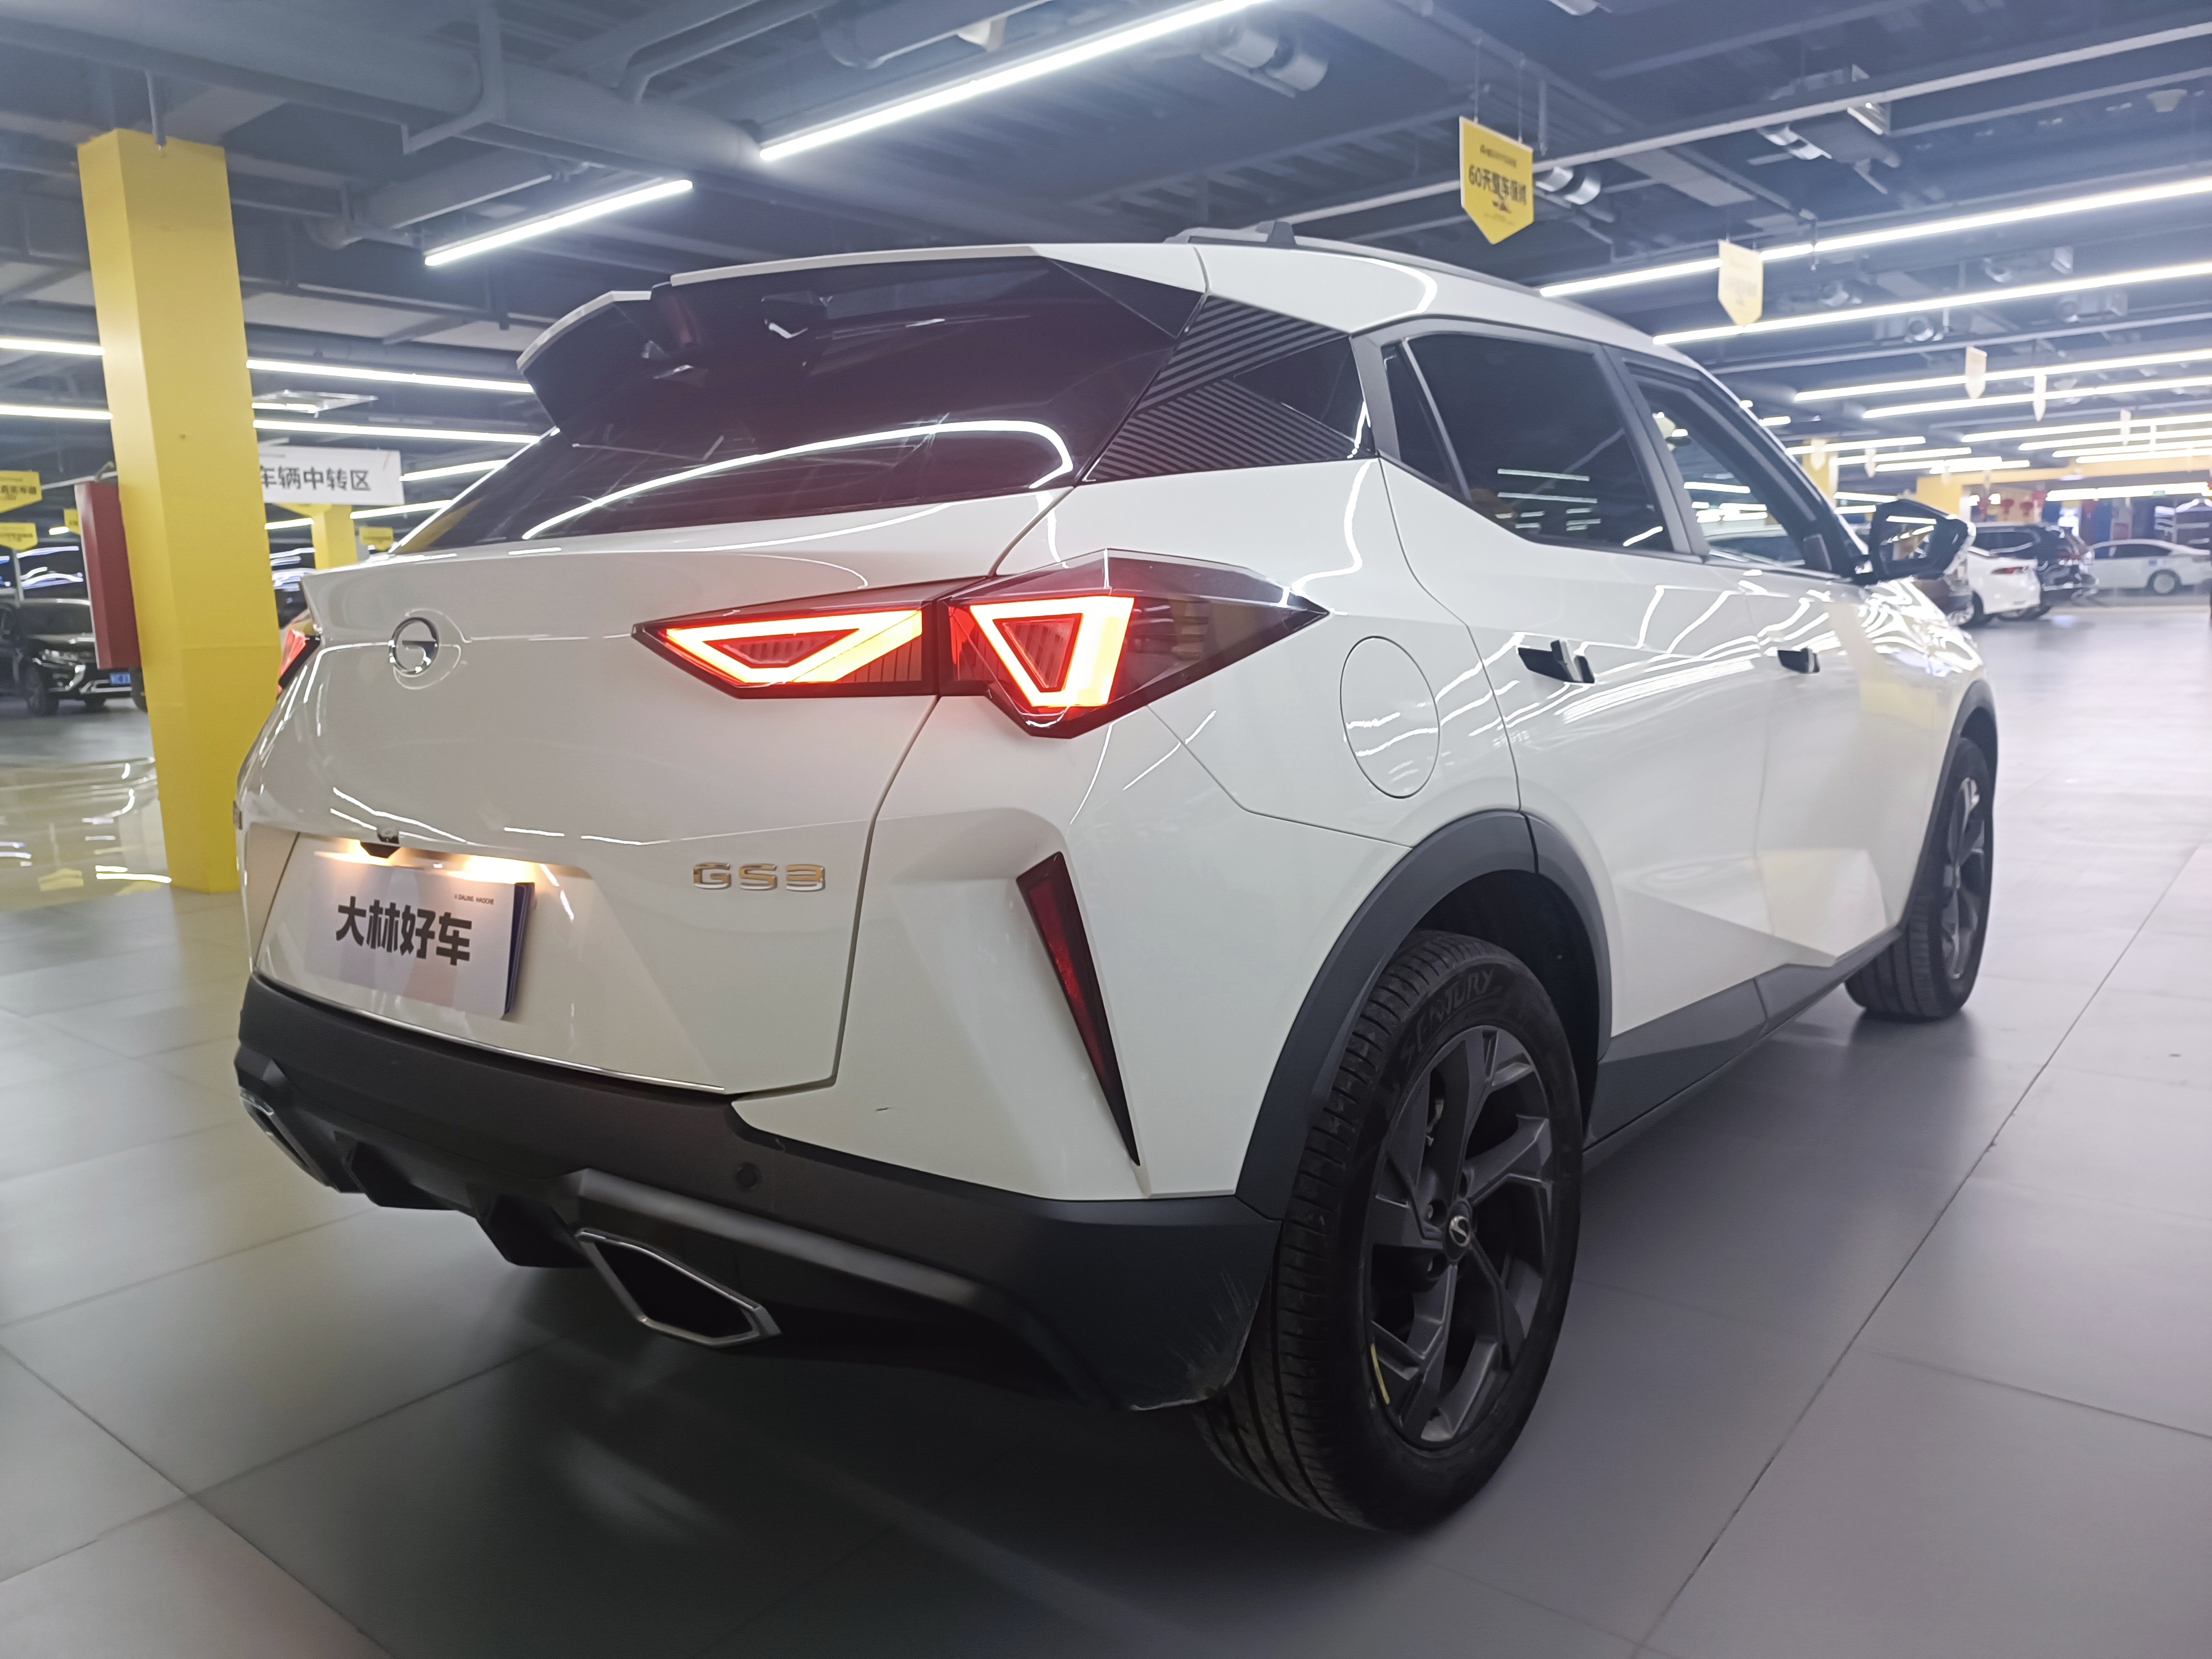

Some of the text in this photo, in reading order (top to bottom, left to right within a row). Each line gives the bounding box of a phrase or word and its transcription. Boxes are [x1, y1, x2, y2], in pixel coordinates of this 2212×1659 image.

[260, 465, 371, 491] 车辆中转区
[693, 862, 826, 891] GS3
[335, 895, 472, 966] 大林好车
